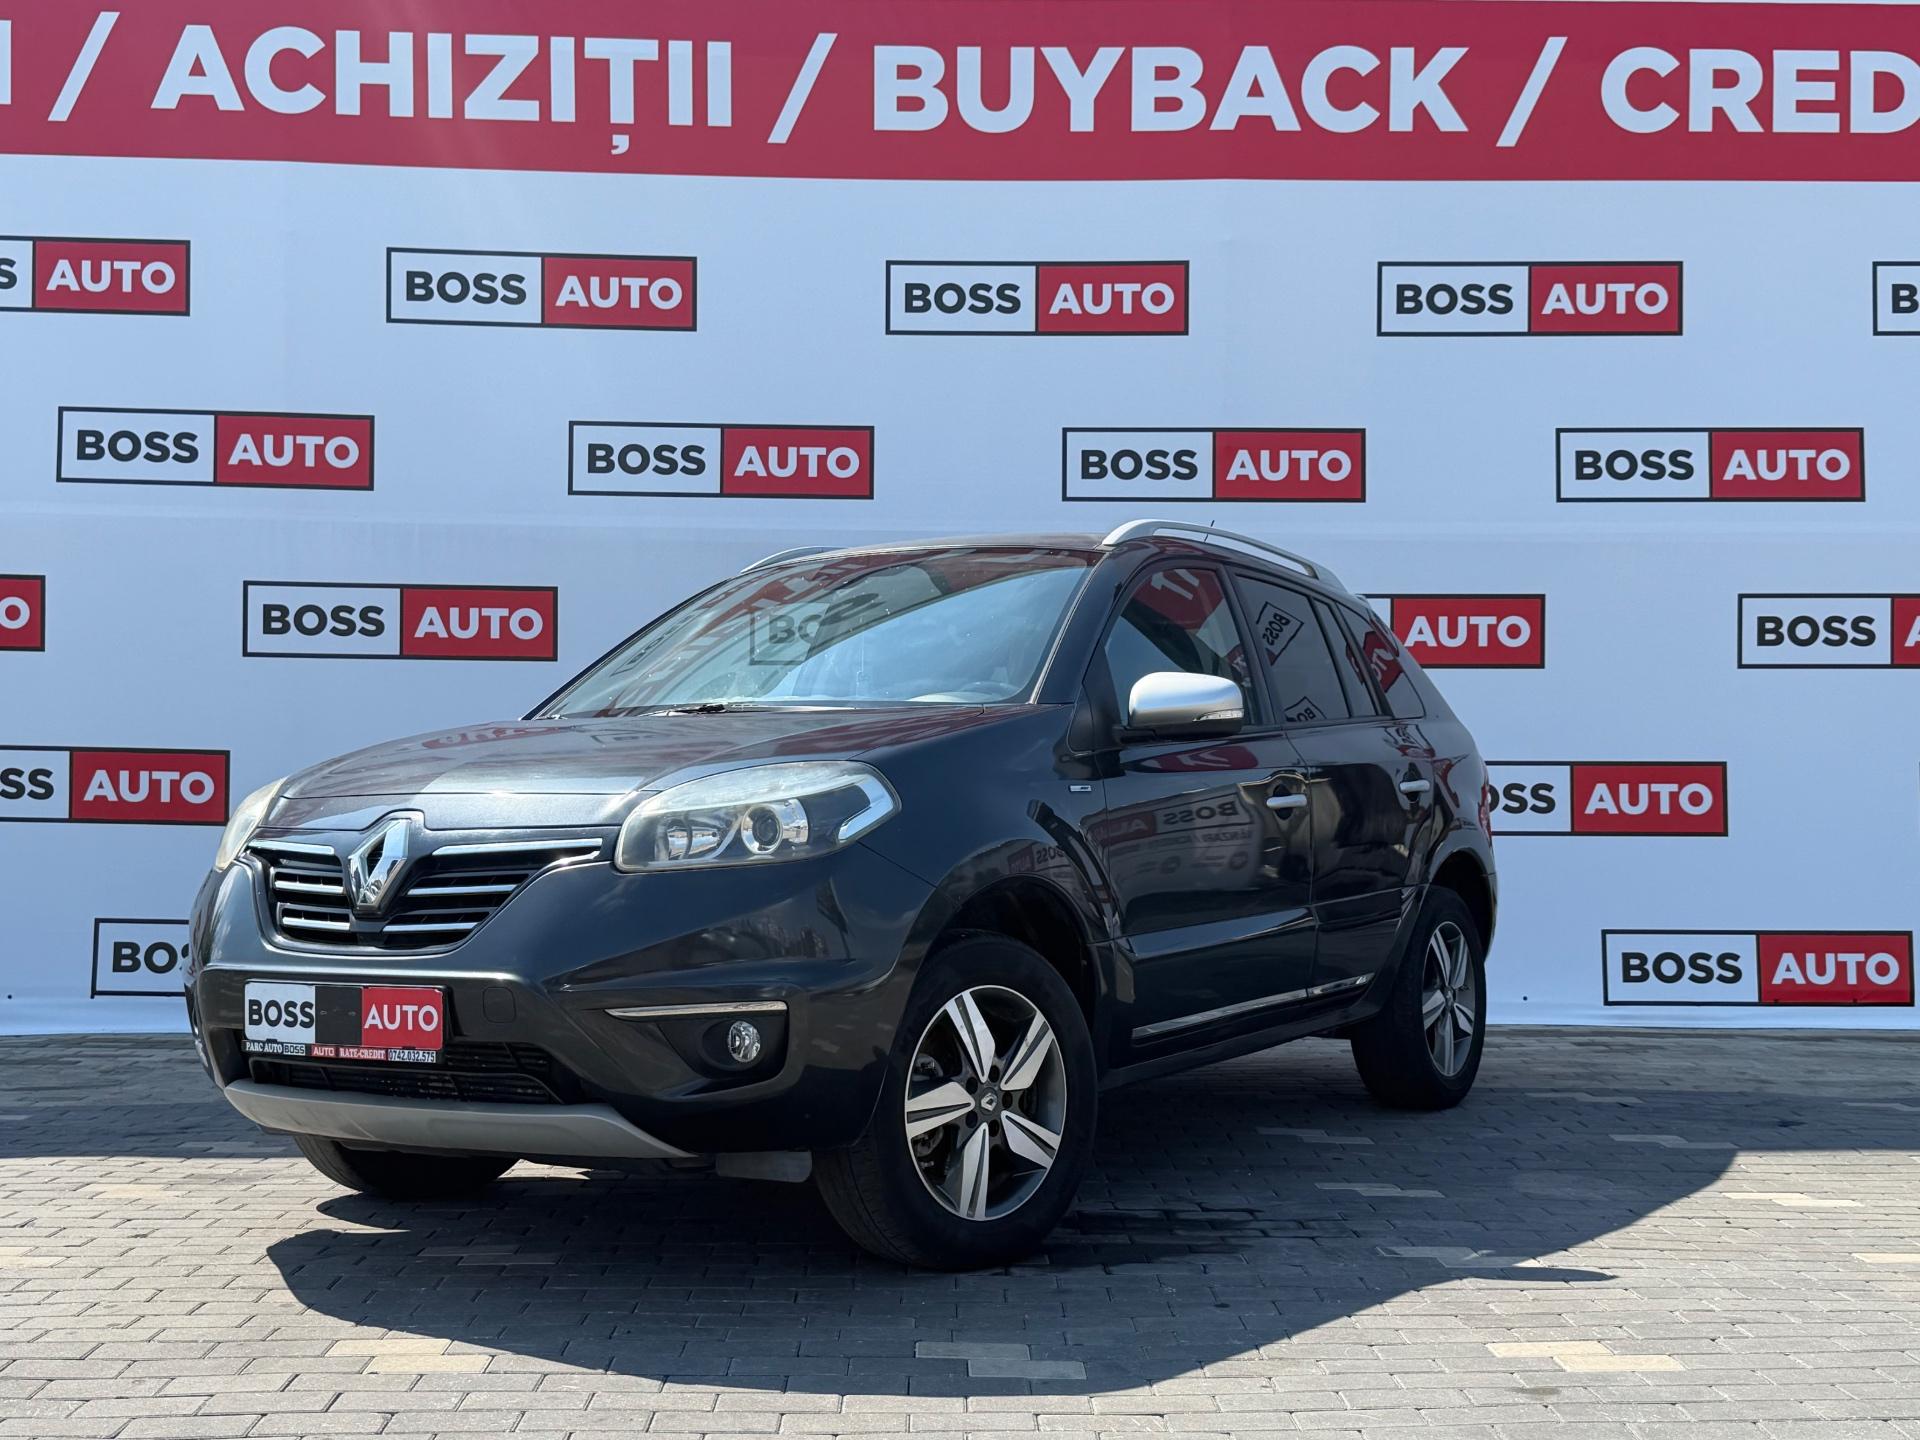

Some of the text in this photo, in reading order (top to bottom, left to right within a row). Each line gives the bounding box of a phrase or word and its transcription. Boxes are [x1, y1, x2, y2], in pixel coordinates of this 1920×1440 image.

[48, 11, 120, 121] /
[152, 25, 731, 155] ACHIZIȚII
[768, 33, 837, 143] /
[874, 45, 1469, 133] BUYBACK
[1496, 37, 1567, 147] /
[1601, 47, 1920, 133] CRED
[46, 260, 175, 293] AUTO
[406, 271, 682, 309] BOSS AUTO
[905, 283, 1174, 314] BOSS AUTO
[1396, 283, 1668, 314] BOSS AUTO
[77, 430, 359, 468] BOSS AUTO
[588, 444, 859, 478] BOSS AUTO
[1575, 449, 1850, 480] BOSS AUTO
[1082, 450, 1351, 481] BOSS AUTO
[263, 604, 543, 639] BOSS AUTO
[769, 614, 822, 645] BO
[1404, 616, 1530, 648] AUTO
[1757, 616, 1876, 646] BOSS
[84, 770, 214, 803] AUTO
[1490, 783, 1712, 814] SS AUTO
[113, 942, 189, 974] BO
[1622, 952, 1899, 985] BOSS AUTO
[249, 999, 438, 1031] BOSS AUTO
[246, 1042, 264, 1051] PARC
[264, 1043, 282, 1053] AUTO
[284, 1044, 305, 1055] BOSS
[313, 1046, 335, 1056] AUTO
[340, 1048, 386, 1060] RATE-CREDIT
